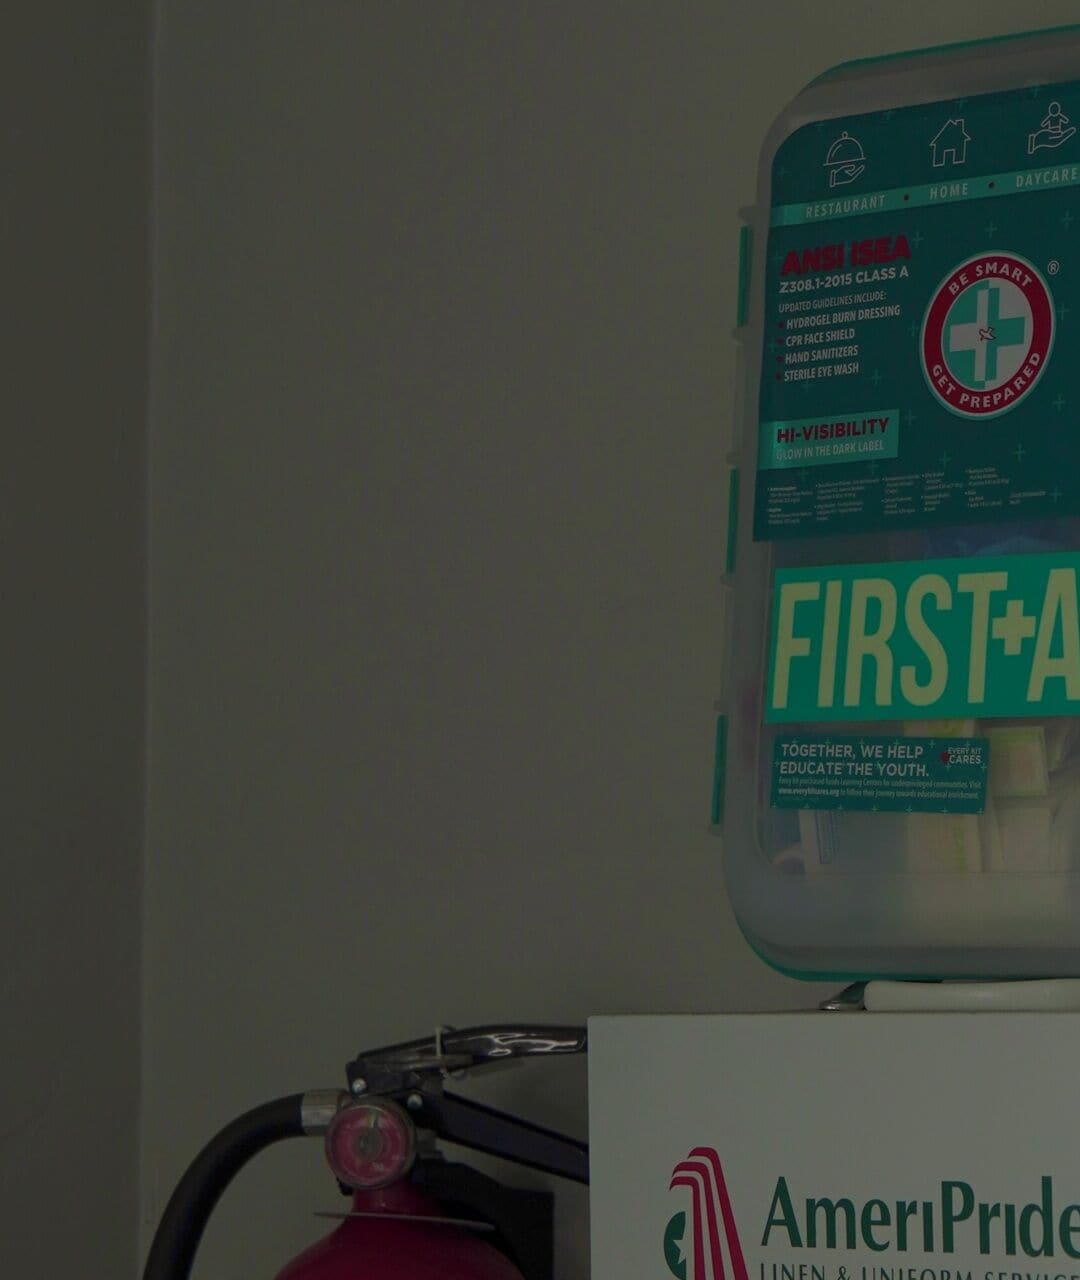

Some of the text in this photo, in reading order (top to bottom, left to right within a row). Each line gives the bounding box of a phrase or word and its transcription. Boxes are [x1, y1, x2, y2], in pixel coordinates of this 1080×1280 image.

[806, 195, 885, 219] RESTAURANT
[929, 182, 969, 201] HOME
[1015, 167, 1079, 188] DAYCARE
[781, 234, 912, 276] ANSI ISEA
[779, 266, 909, 293] Z308.1-2015 CLASS A
[948, 262, 1033, 295] BE SMART
[778, 290, 887, 313] UPDATED GUIDELINES INCLUDE:
[786, 305, 900, 330] HYDROGEL BURN DRESSING
[785, 328, 855, 347] CPR FACE SHIELD
[785, 345, 858, 364] HAND SANITIZERS
[784, 363, 859, 382] STERILE EYE WASH
[932, 352, 1041, 408] GET PREPARED
[777, 417, 890, 444] HI-VISIBILITY
[776, 439, 885, 462] GLOW IN THE DARK LABEL
[781, 743, 924, 760] TOGETHER, WE HELP
[948, 747, 969, 755] EVERY
[949, 754, 982, 765] CARES
[780, 762, 930, 777] EDUCATE THE YOUTH.
